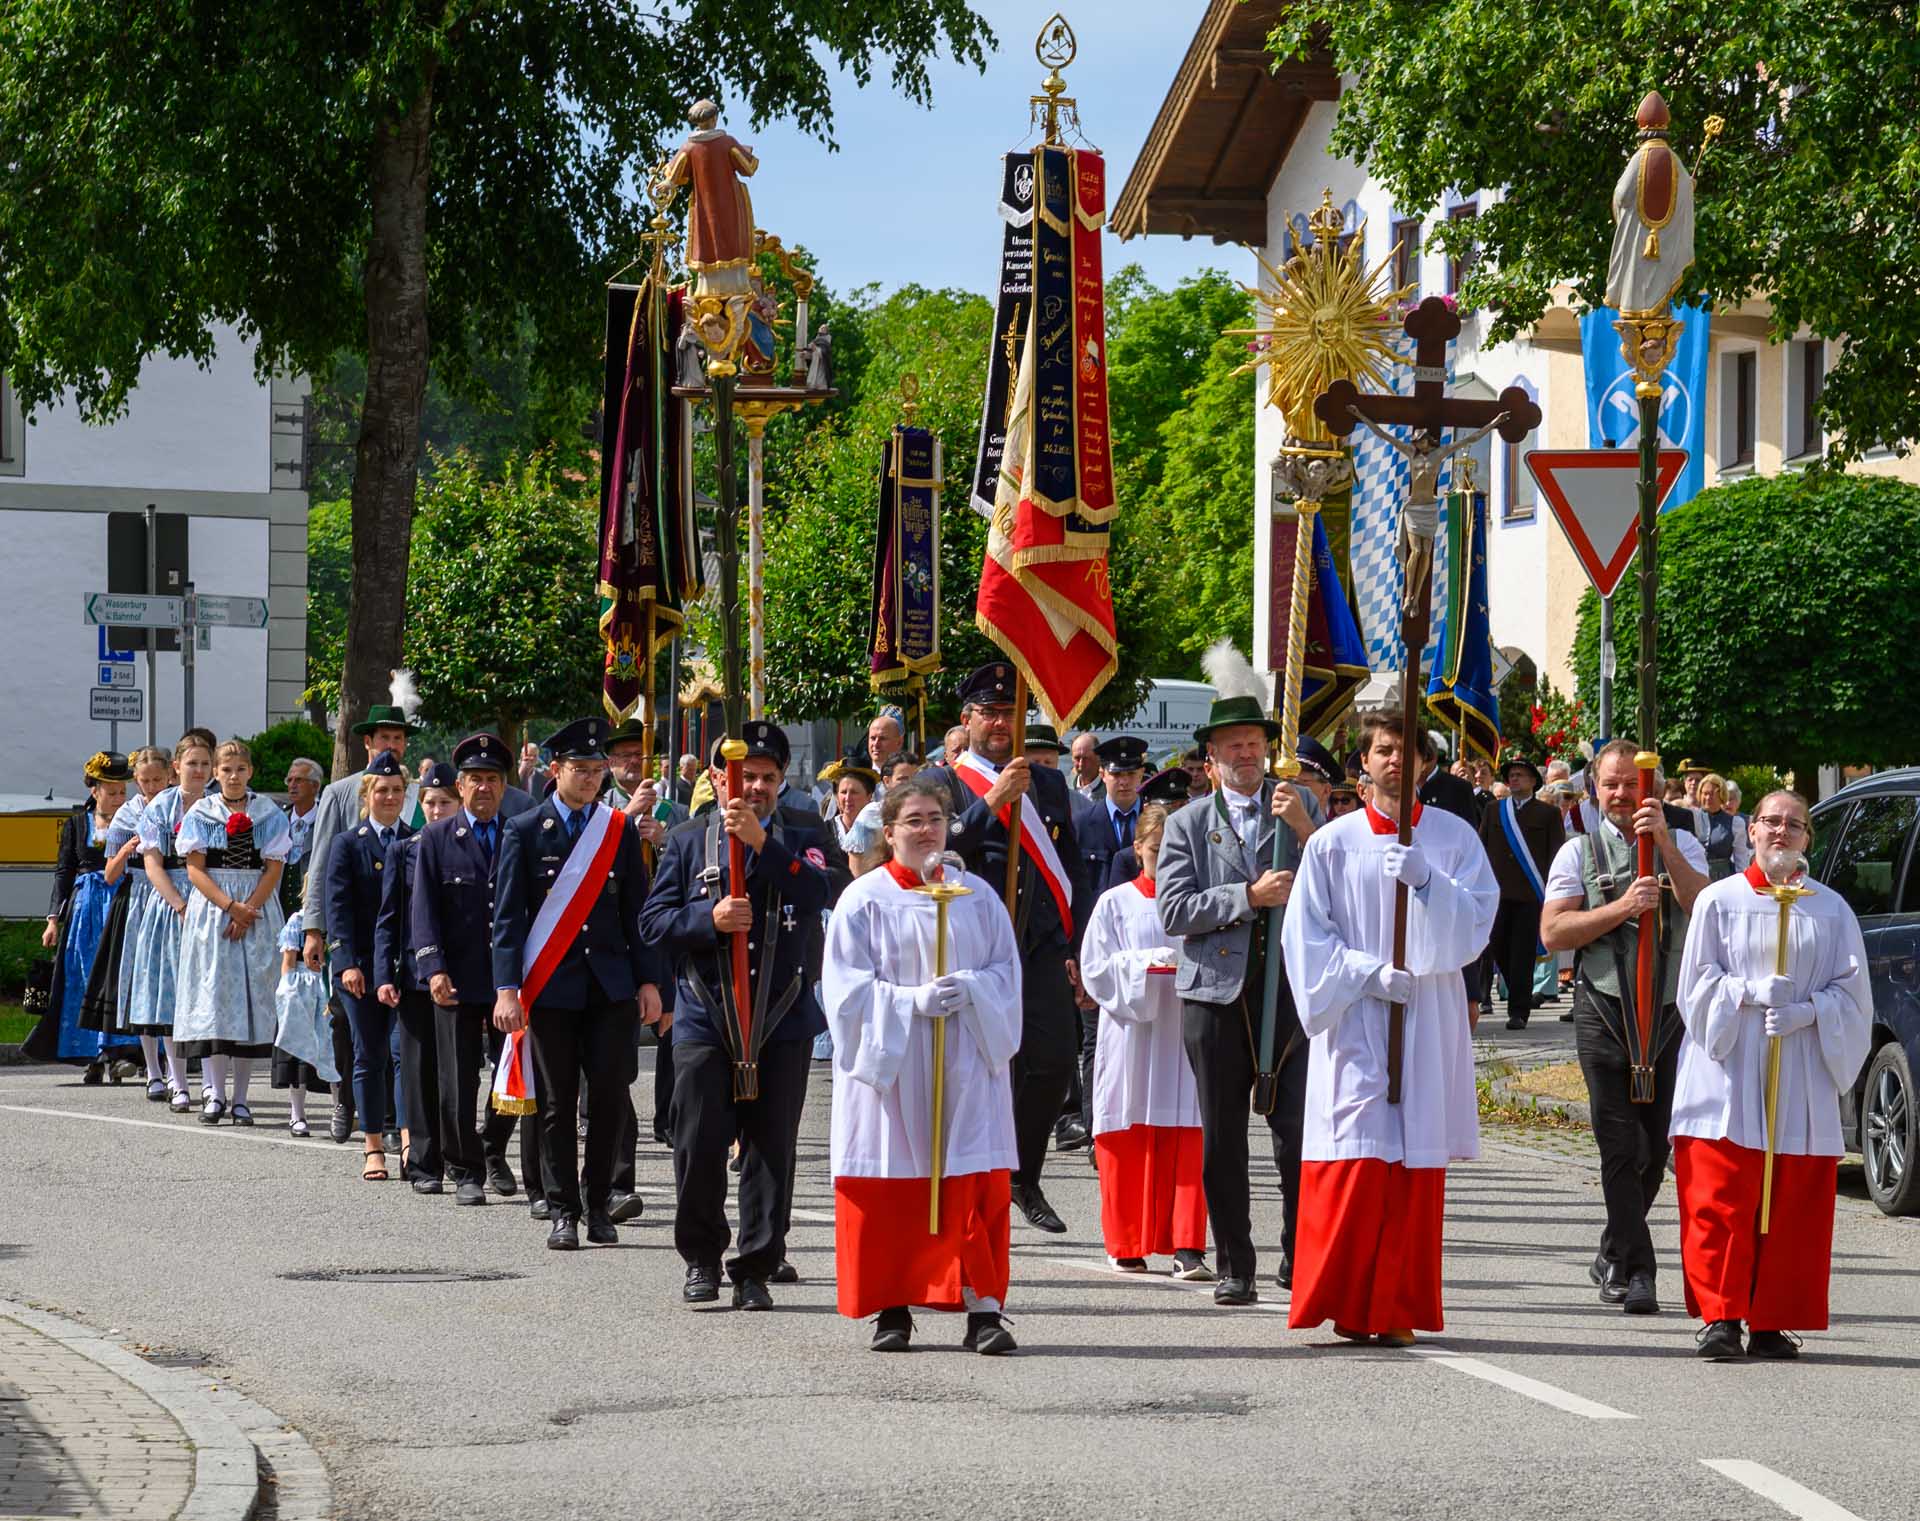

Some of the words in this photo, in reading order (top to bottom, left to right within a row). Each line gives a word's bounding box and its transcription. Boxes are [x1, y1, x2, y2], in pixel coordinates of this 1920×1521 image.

[1015, 272, 1027, 280] zum
[104, 599, 148, 611] Wasserburg
[112, 611, 142, 621] Bahnhof
[94, 695, 120, 704] werktags
[93, 707, 120, 717] samstags
